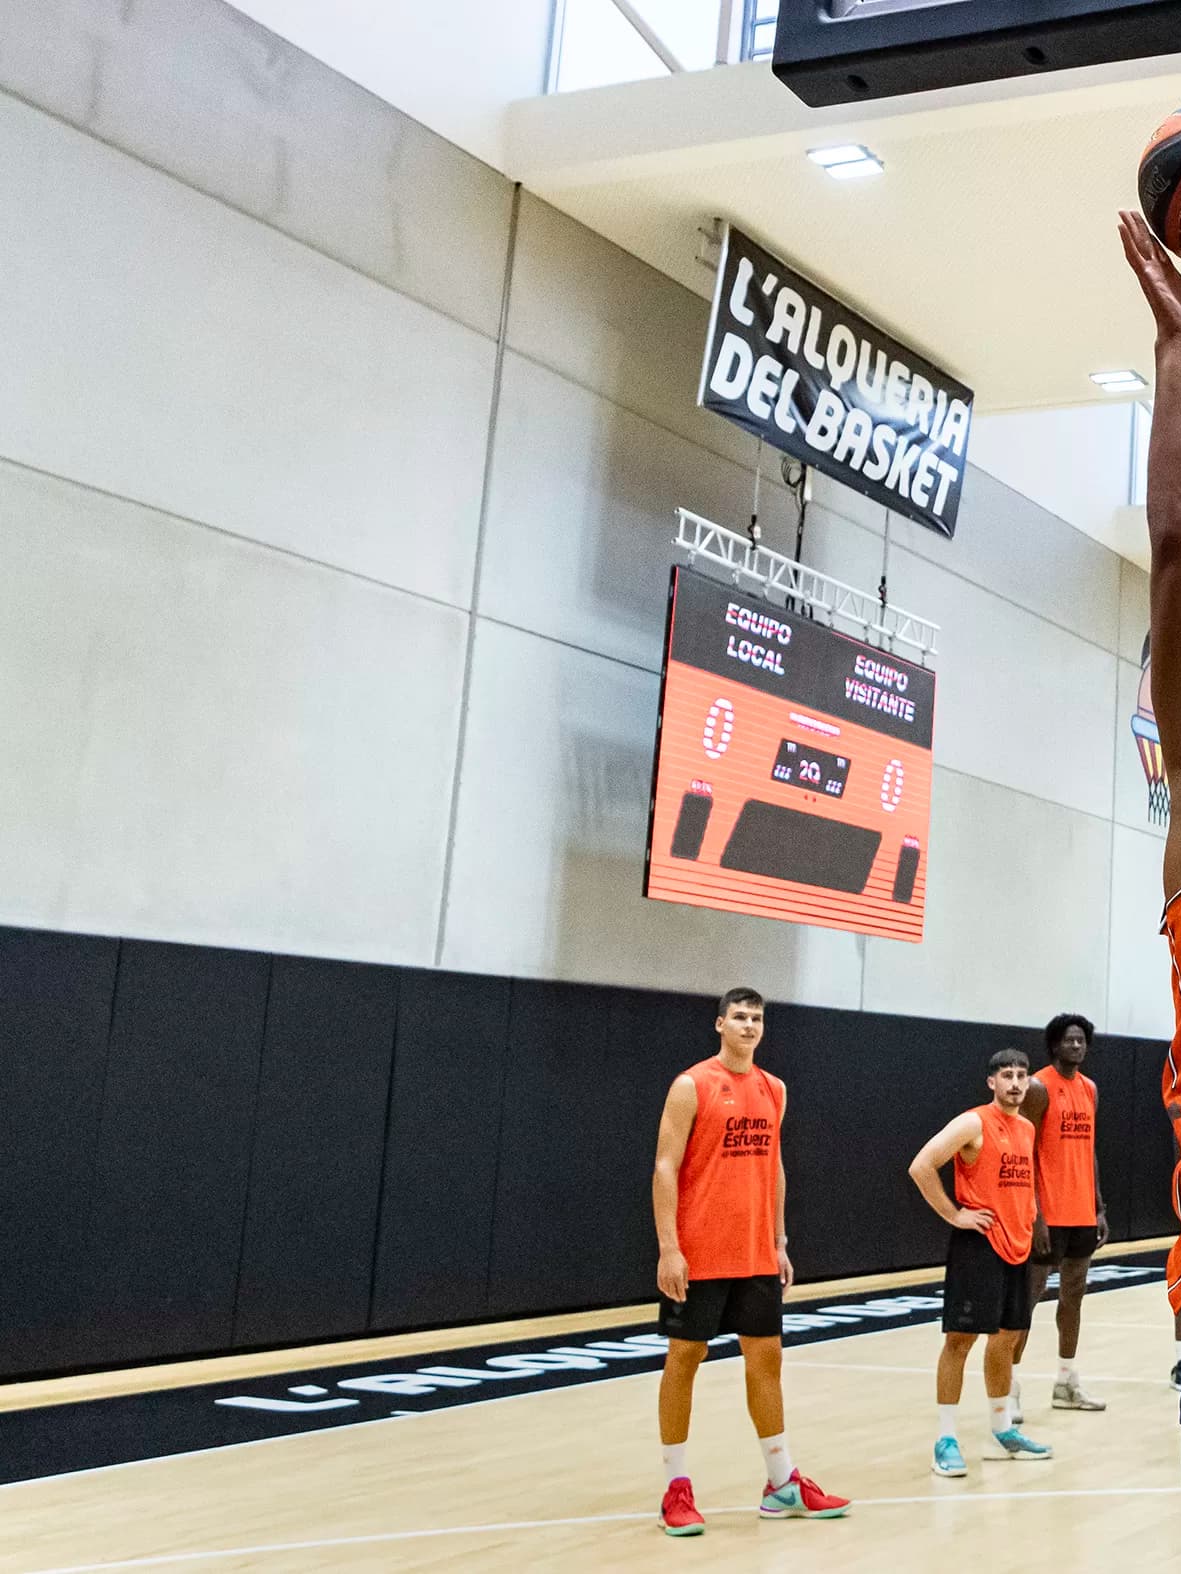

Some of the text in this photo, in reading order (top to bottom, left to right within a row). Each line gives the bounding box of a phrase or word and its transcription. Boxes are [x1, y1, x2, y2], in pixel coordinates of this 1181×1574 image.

[729, 256, 971, 456] L'ALQUERIA
[709, 331, 958, 516] DEL BASKET
[725, 602, 793, 646] EQUIPO
[726, 635, 785, 676] LOCAL
[854, 655, 908, 693] EQUIPO
[844, 677, 916, 723] VISITANTE
[703, 698, 734, 760] 0
[880, 759, 905, 813] 0
